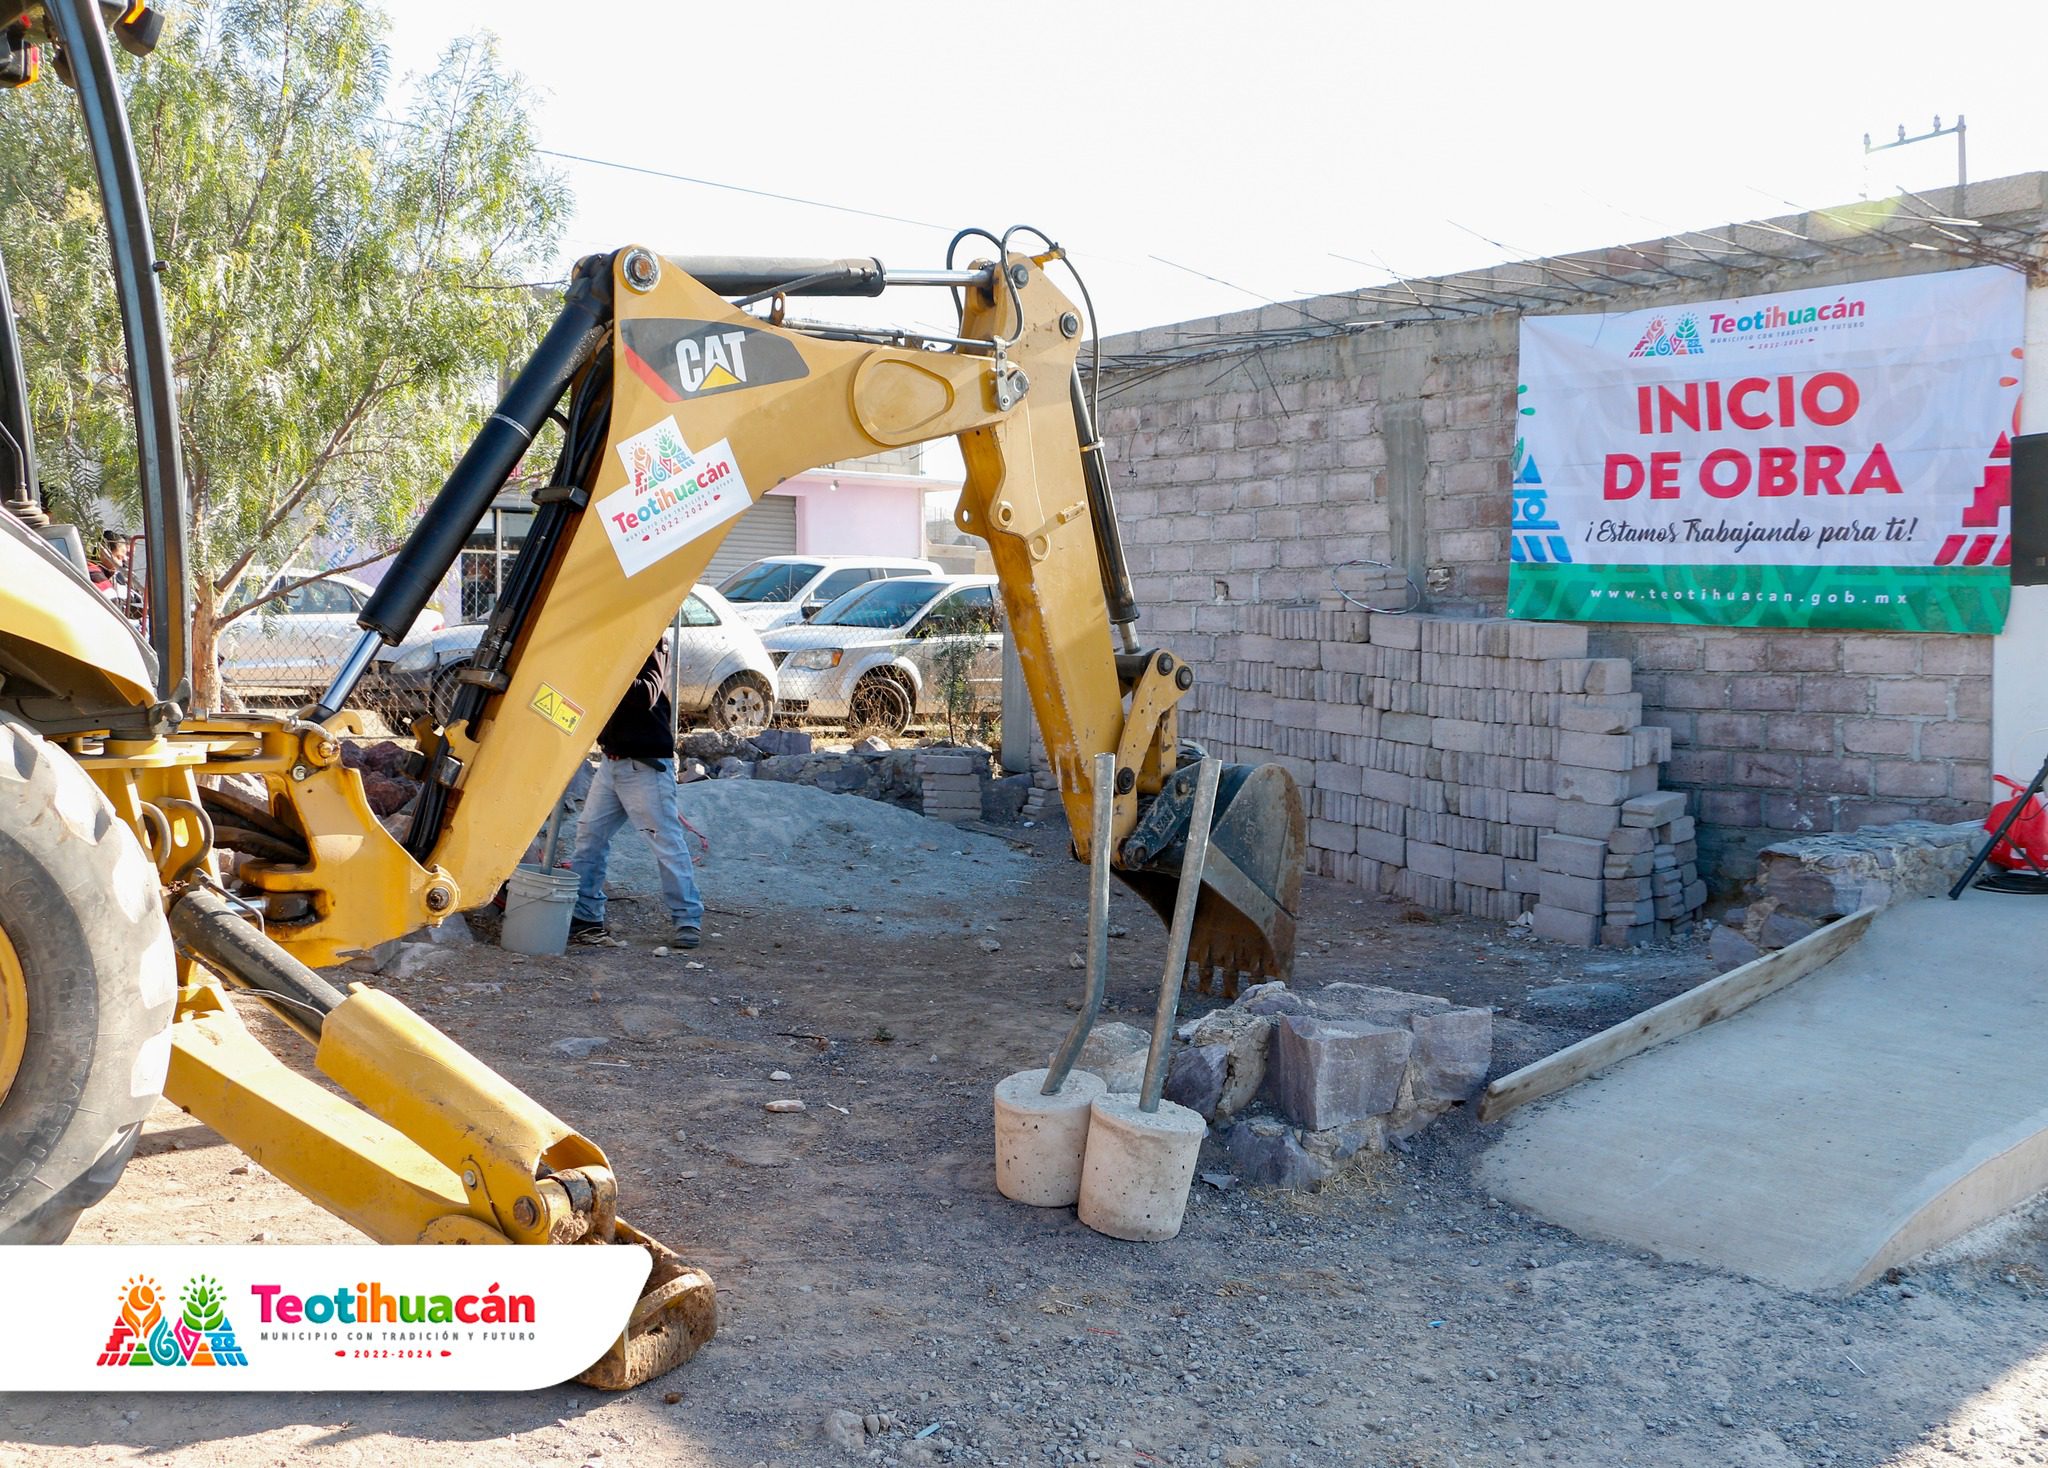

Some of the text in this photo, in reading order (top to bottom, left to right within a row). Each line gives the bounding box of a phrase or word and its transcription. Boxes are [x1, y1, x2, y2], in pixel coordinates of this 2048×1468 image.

[1710, 296, 1865, 334] Teotihuacán
[676, 331, 747, 392] CAT
[1637, 372, 1860, 434] INICIO
[612, 461, 730, 534] Teotihuacán
[1603, 443, 1904, 500] DE OBRA
[1585, 517, 1919, 553] ¡Estamos Trabajando para ti!
[1590, 588, 1907, 607] www.teotihuacan.gob.mx
